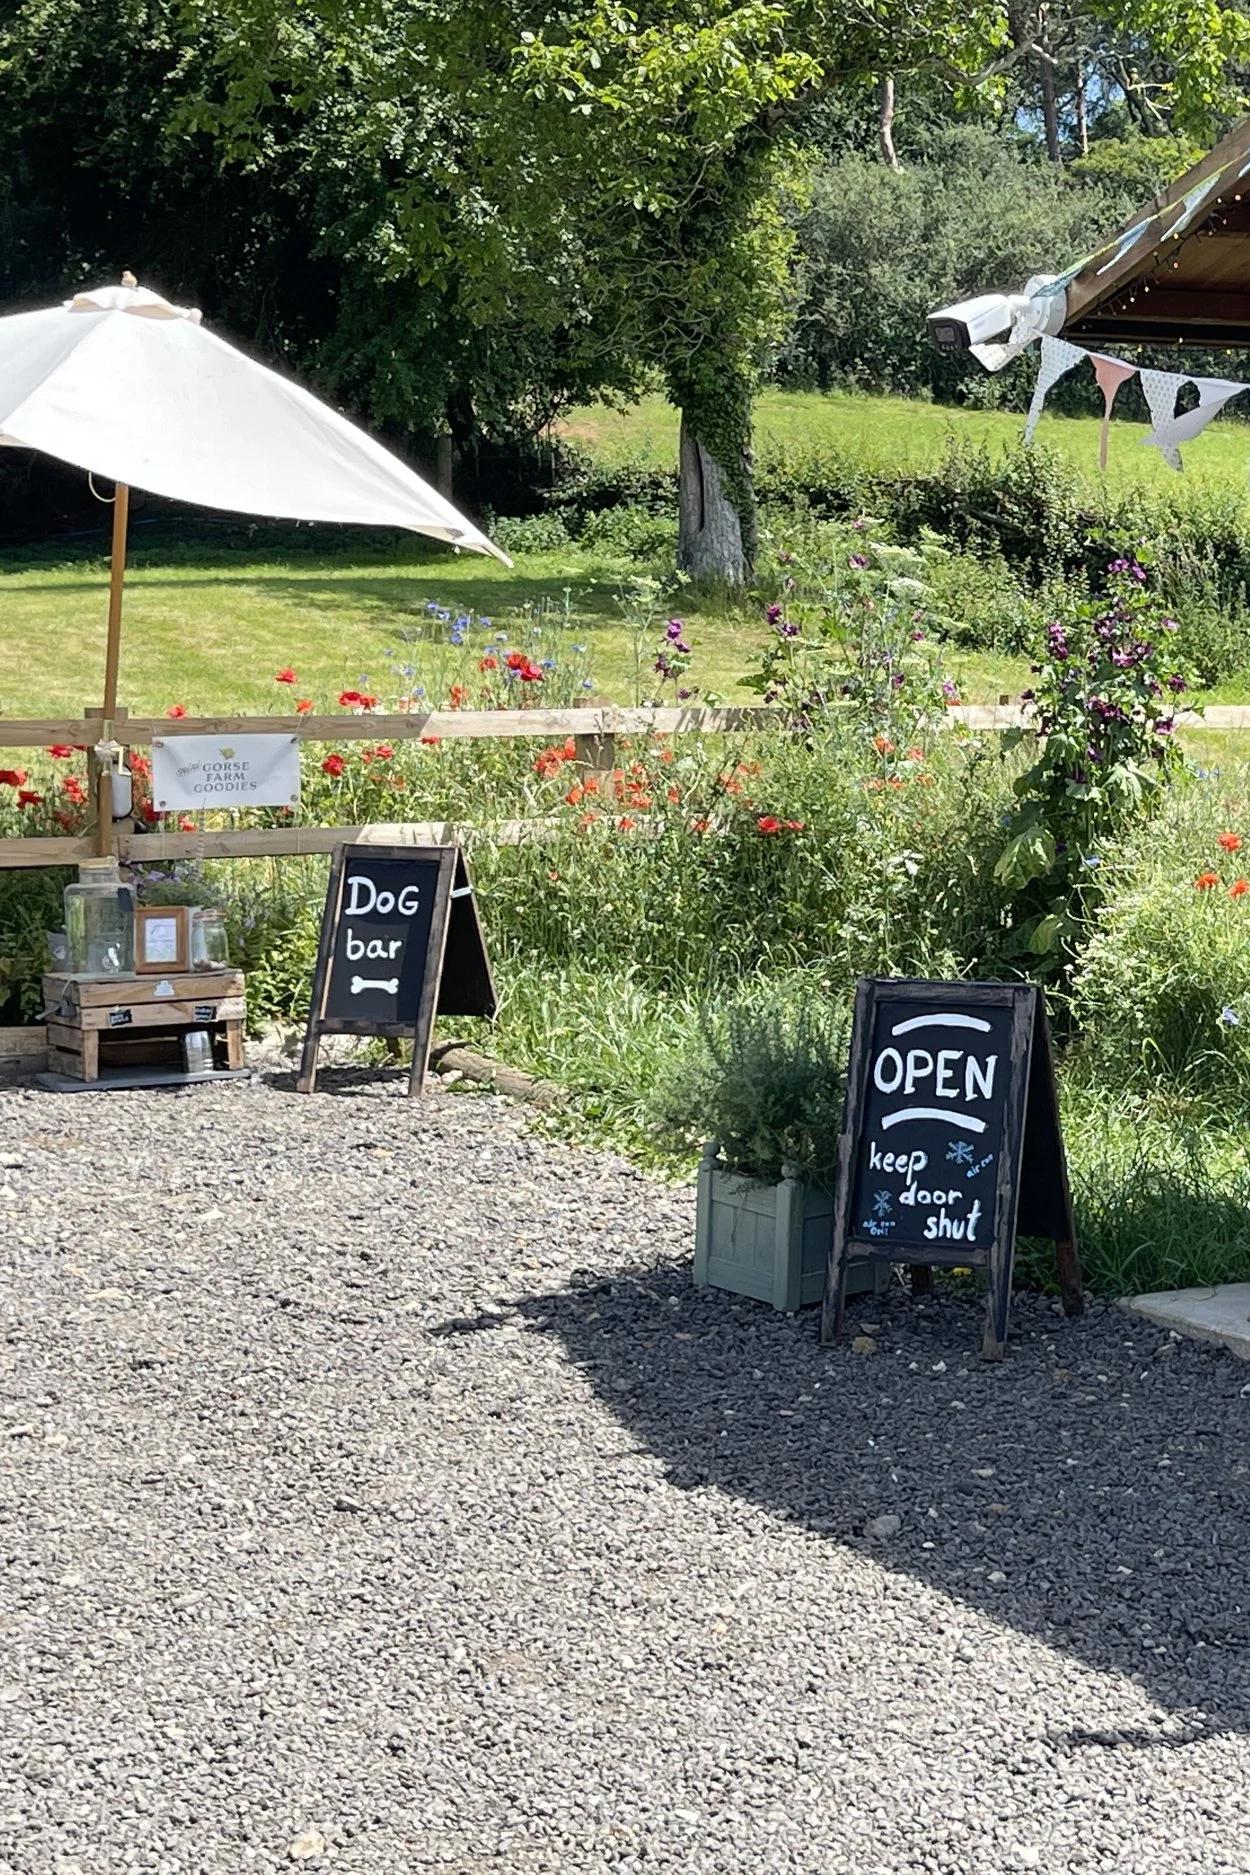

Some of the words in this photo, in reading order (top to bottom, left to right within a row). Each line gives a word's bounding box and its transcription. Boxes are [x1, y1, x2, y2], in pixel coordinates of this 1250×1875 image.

[202, 761, 250, 772] GORSE
[206, 773, 246, 782] FARM
[193, 781, 258, 794] GOODIES
[346, 928, 402, 961] bar
[873, 1047, 999, 1102] OPEN
[869, 1141, 928, 1187] keep
[898, 1180, 963, 1207] door
[923, 1199, 982, 1242] shut
